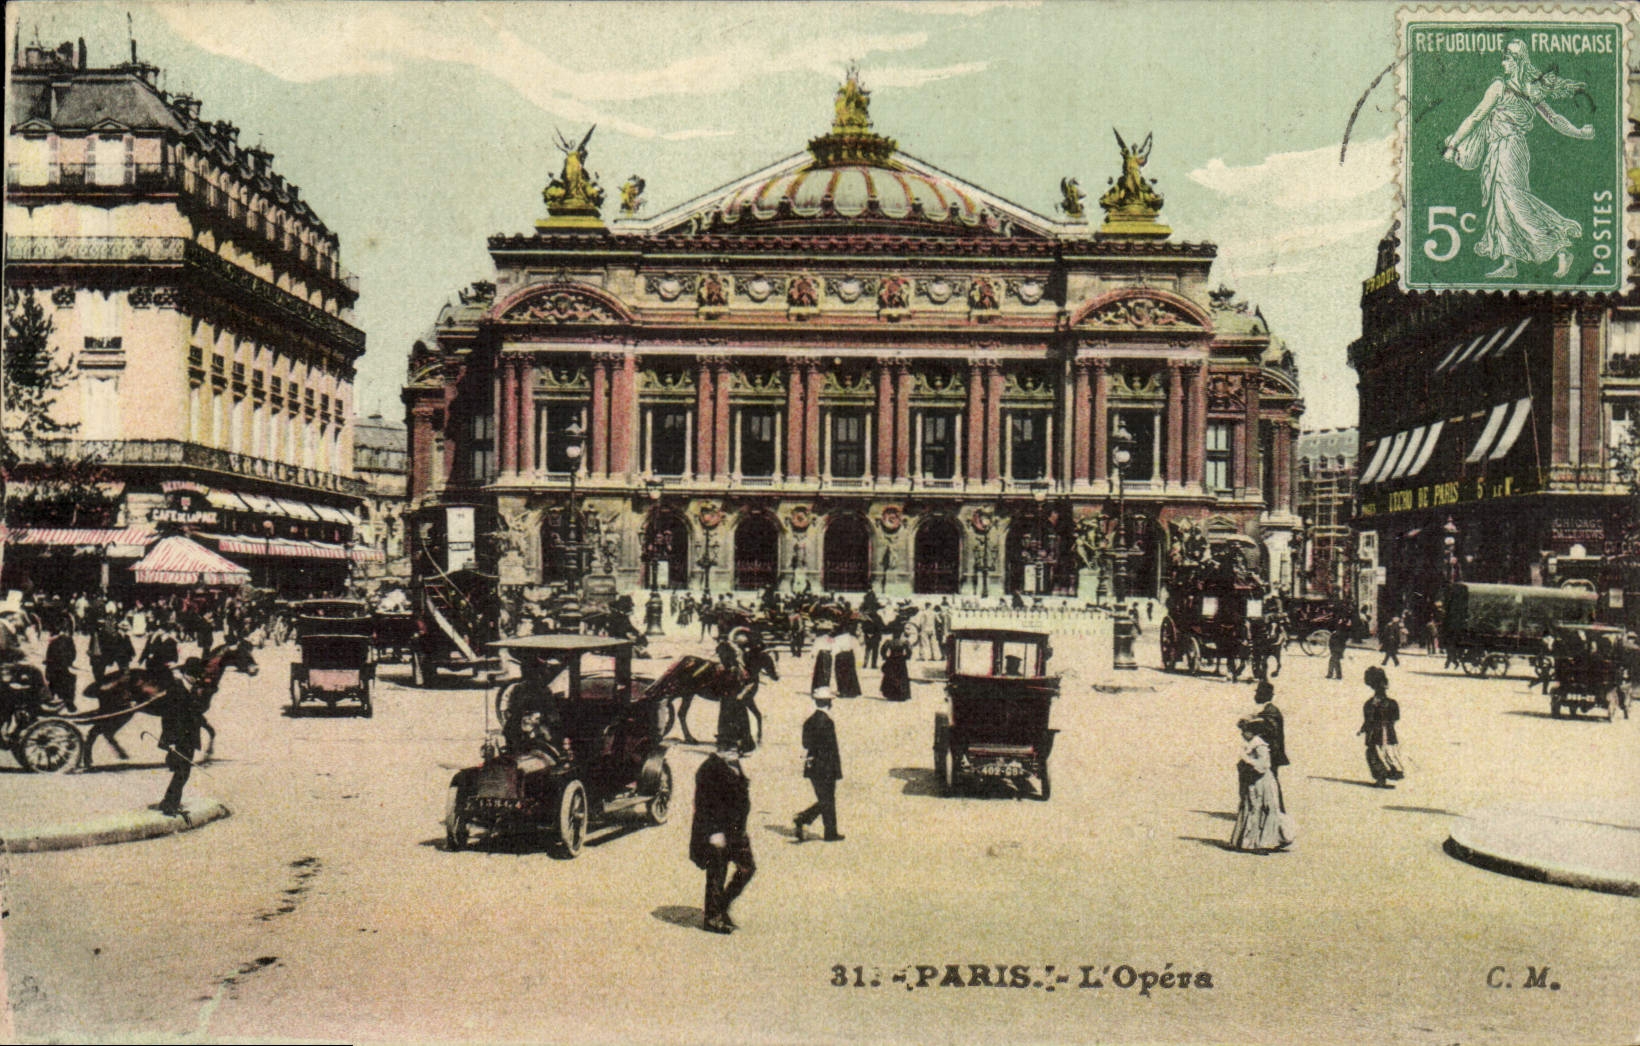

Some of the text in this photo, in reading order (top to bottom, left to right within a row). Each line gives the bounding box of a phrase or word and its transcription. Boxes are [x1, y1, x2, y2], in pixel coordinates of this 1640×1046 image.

[1531, 33, 1613, 55] FRANÇAISE
[1593, 190, 1612, 275] POSTES
[1418, 486, 1429, 508] DE
[1434, 481, 1459, 506] PARIS
